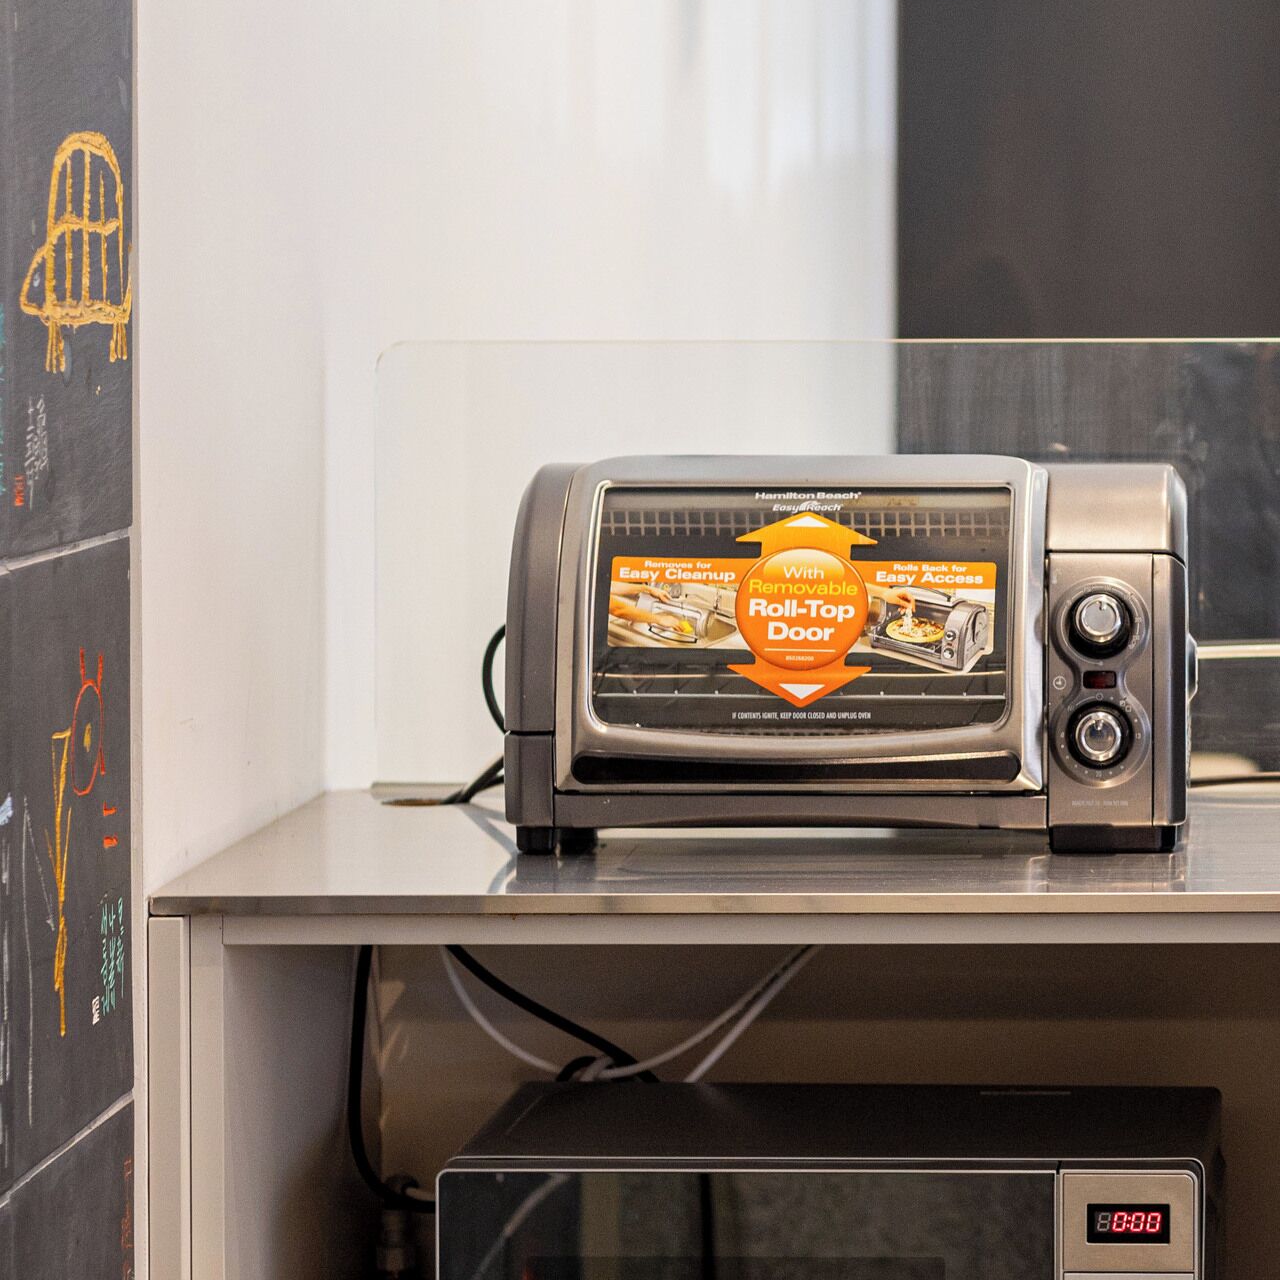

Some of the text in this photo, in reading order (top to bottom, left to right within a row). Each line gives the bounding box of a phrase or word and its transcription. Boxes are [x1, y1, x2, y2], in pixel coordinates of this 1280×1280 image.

[755, 492, 860, 500] Hamilton Beach
[644, 560, 712, 570] Removes for
[783, 565, 825, 580] With
[893, 563, 968, 572] Rolls Back for
[619, 568, 736, 584] Easy Cleanup
[876, 571, 984, 586] Easy Access
[748, 579, 858, 596] Removable
[748, 600, 856, 623] Roll-Top
[766, 622, 835, 642] Door
